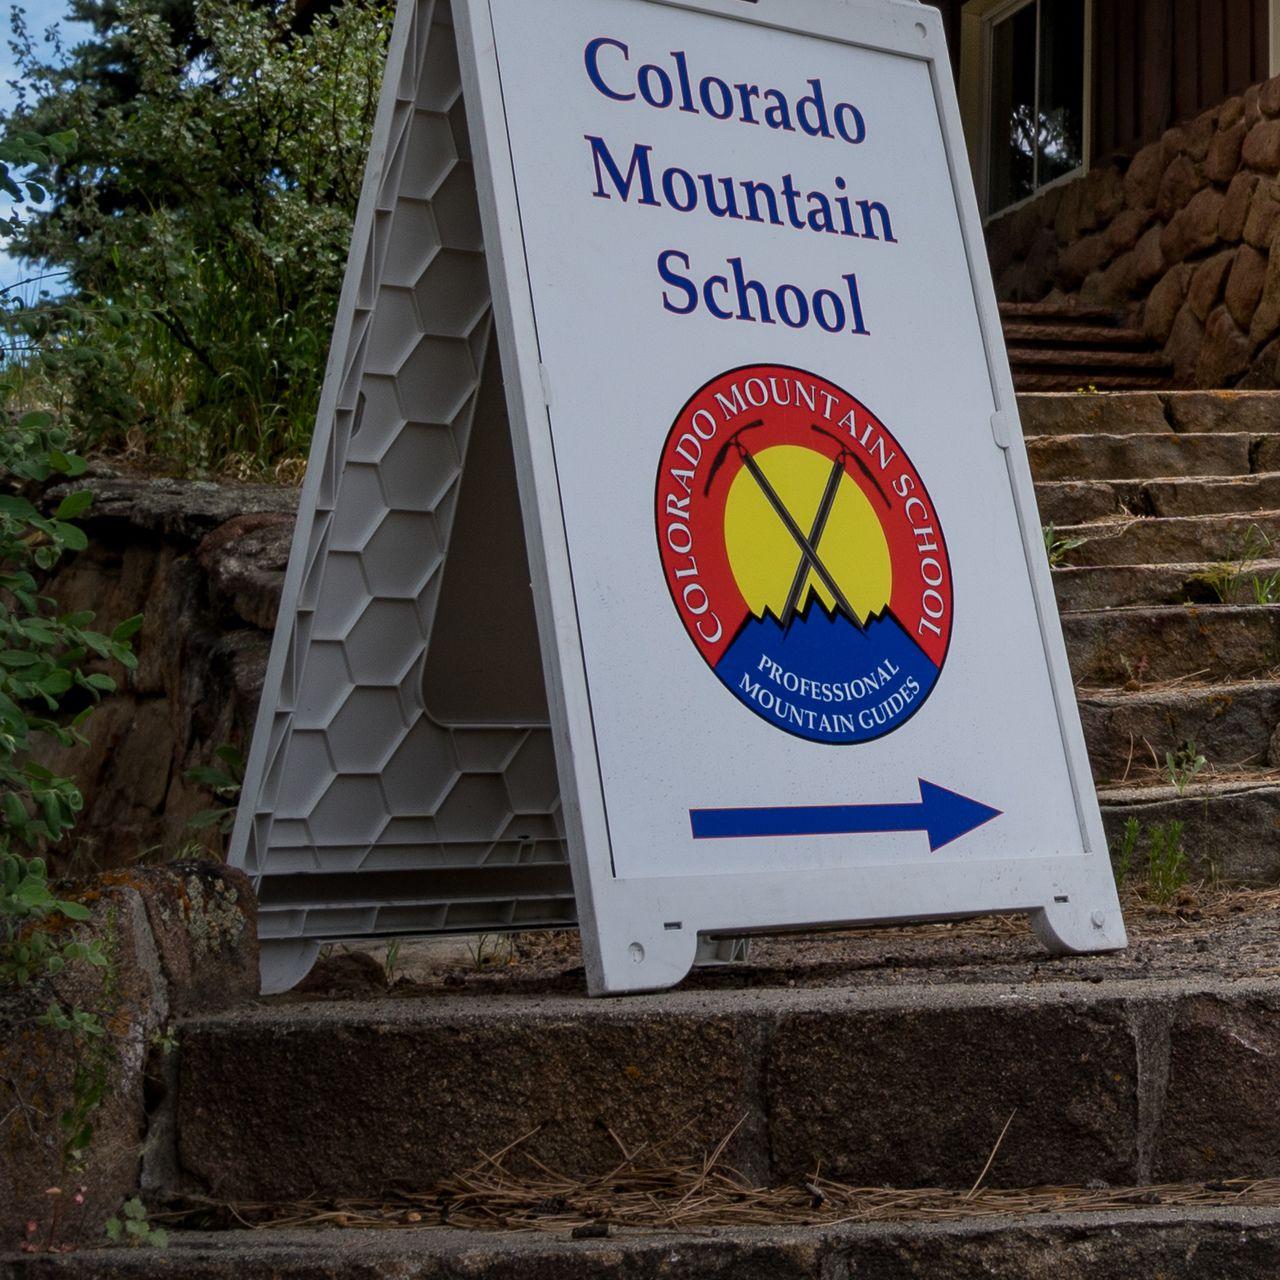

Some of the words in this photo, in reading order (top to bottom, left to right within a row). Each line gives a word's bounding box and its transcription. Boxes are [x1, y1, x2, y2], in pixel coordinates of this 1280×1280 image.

[584, 37, 866, 145] Colorado
[583, 134, 898, 244] Mountain
[657, 249, 871, 336] School
[667, 409, 724, 644] COLORADO
[714, 376, 897, 471] MOUNTAIN
[891, 473, 944, 637] SCHOOL
[738, 673, 855, 733] MOUNTAIN
[858, 676, 921, 730] GUIDES
[757, 654, 901, 702] PROFESSIONAL
